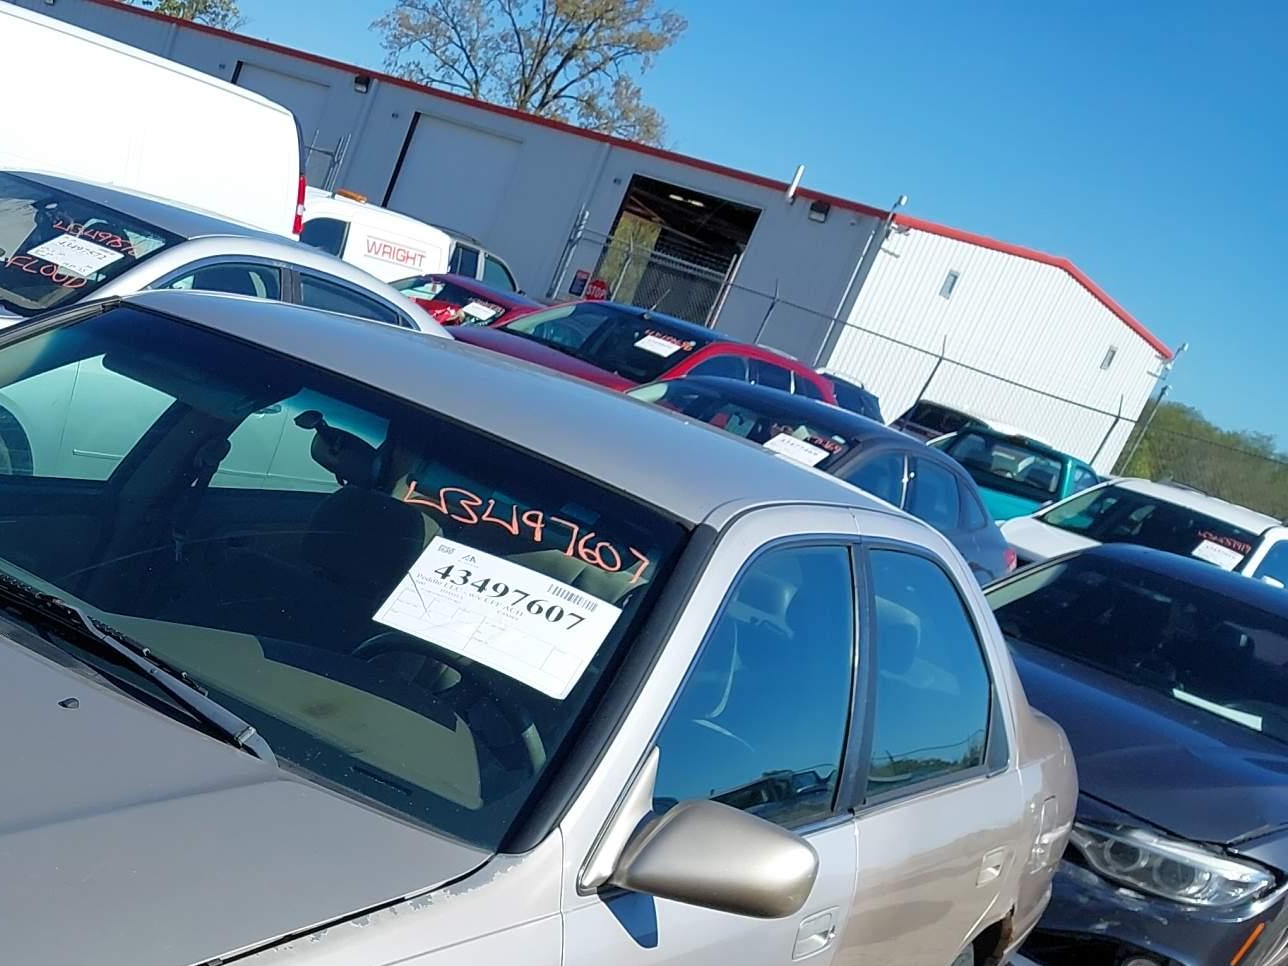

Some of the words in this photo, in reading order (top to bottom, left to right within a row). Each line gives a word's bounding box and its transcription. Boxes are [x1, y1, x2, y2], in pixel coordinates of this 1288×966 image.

[366, 239, 427, 267] WRIGHT
[5, 256, 88, 289] FLOOD
[586, 283, 607, 299] STOP
[433, 564, 586, 630] 43497607
